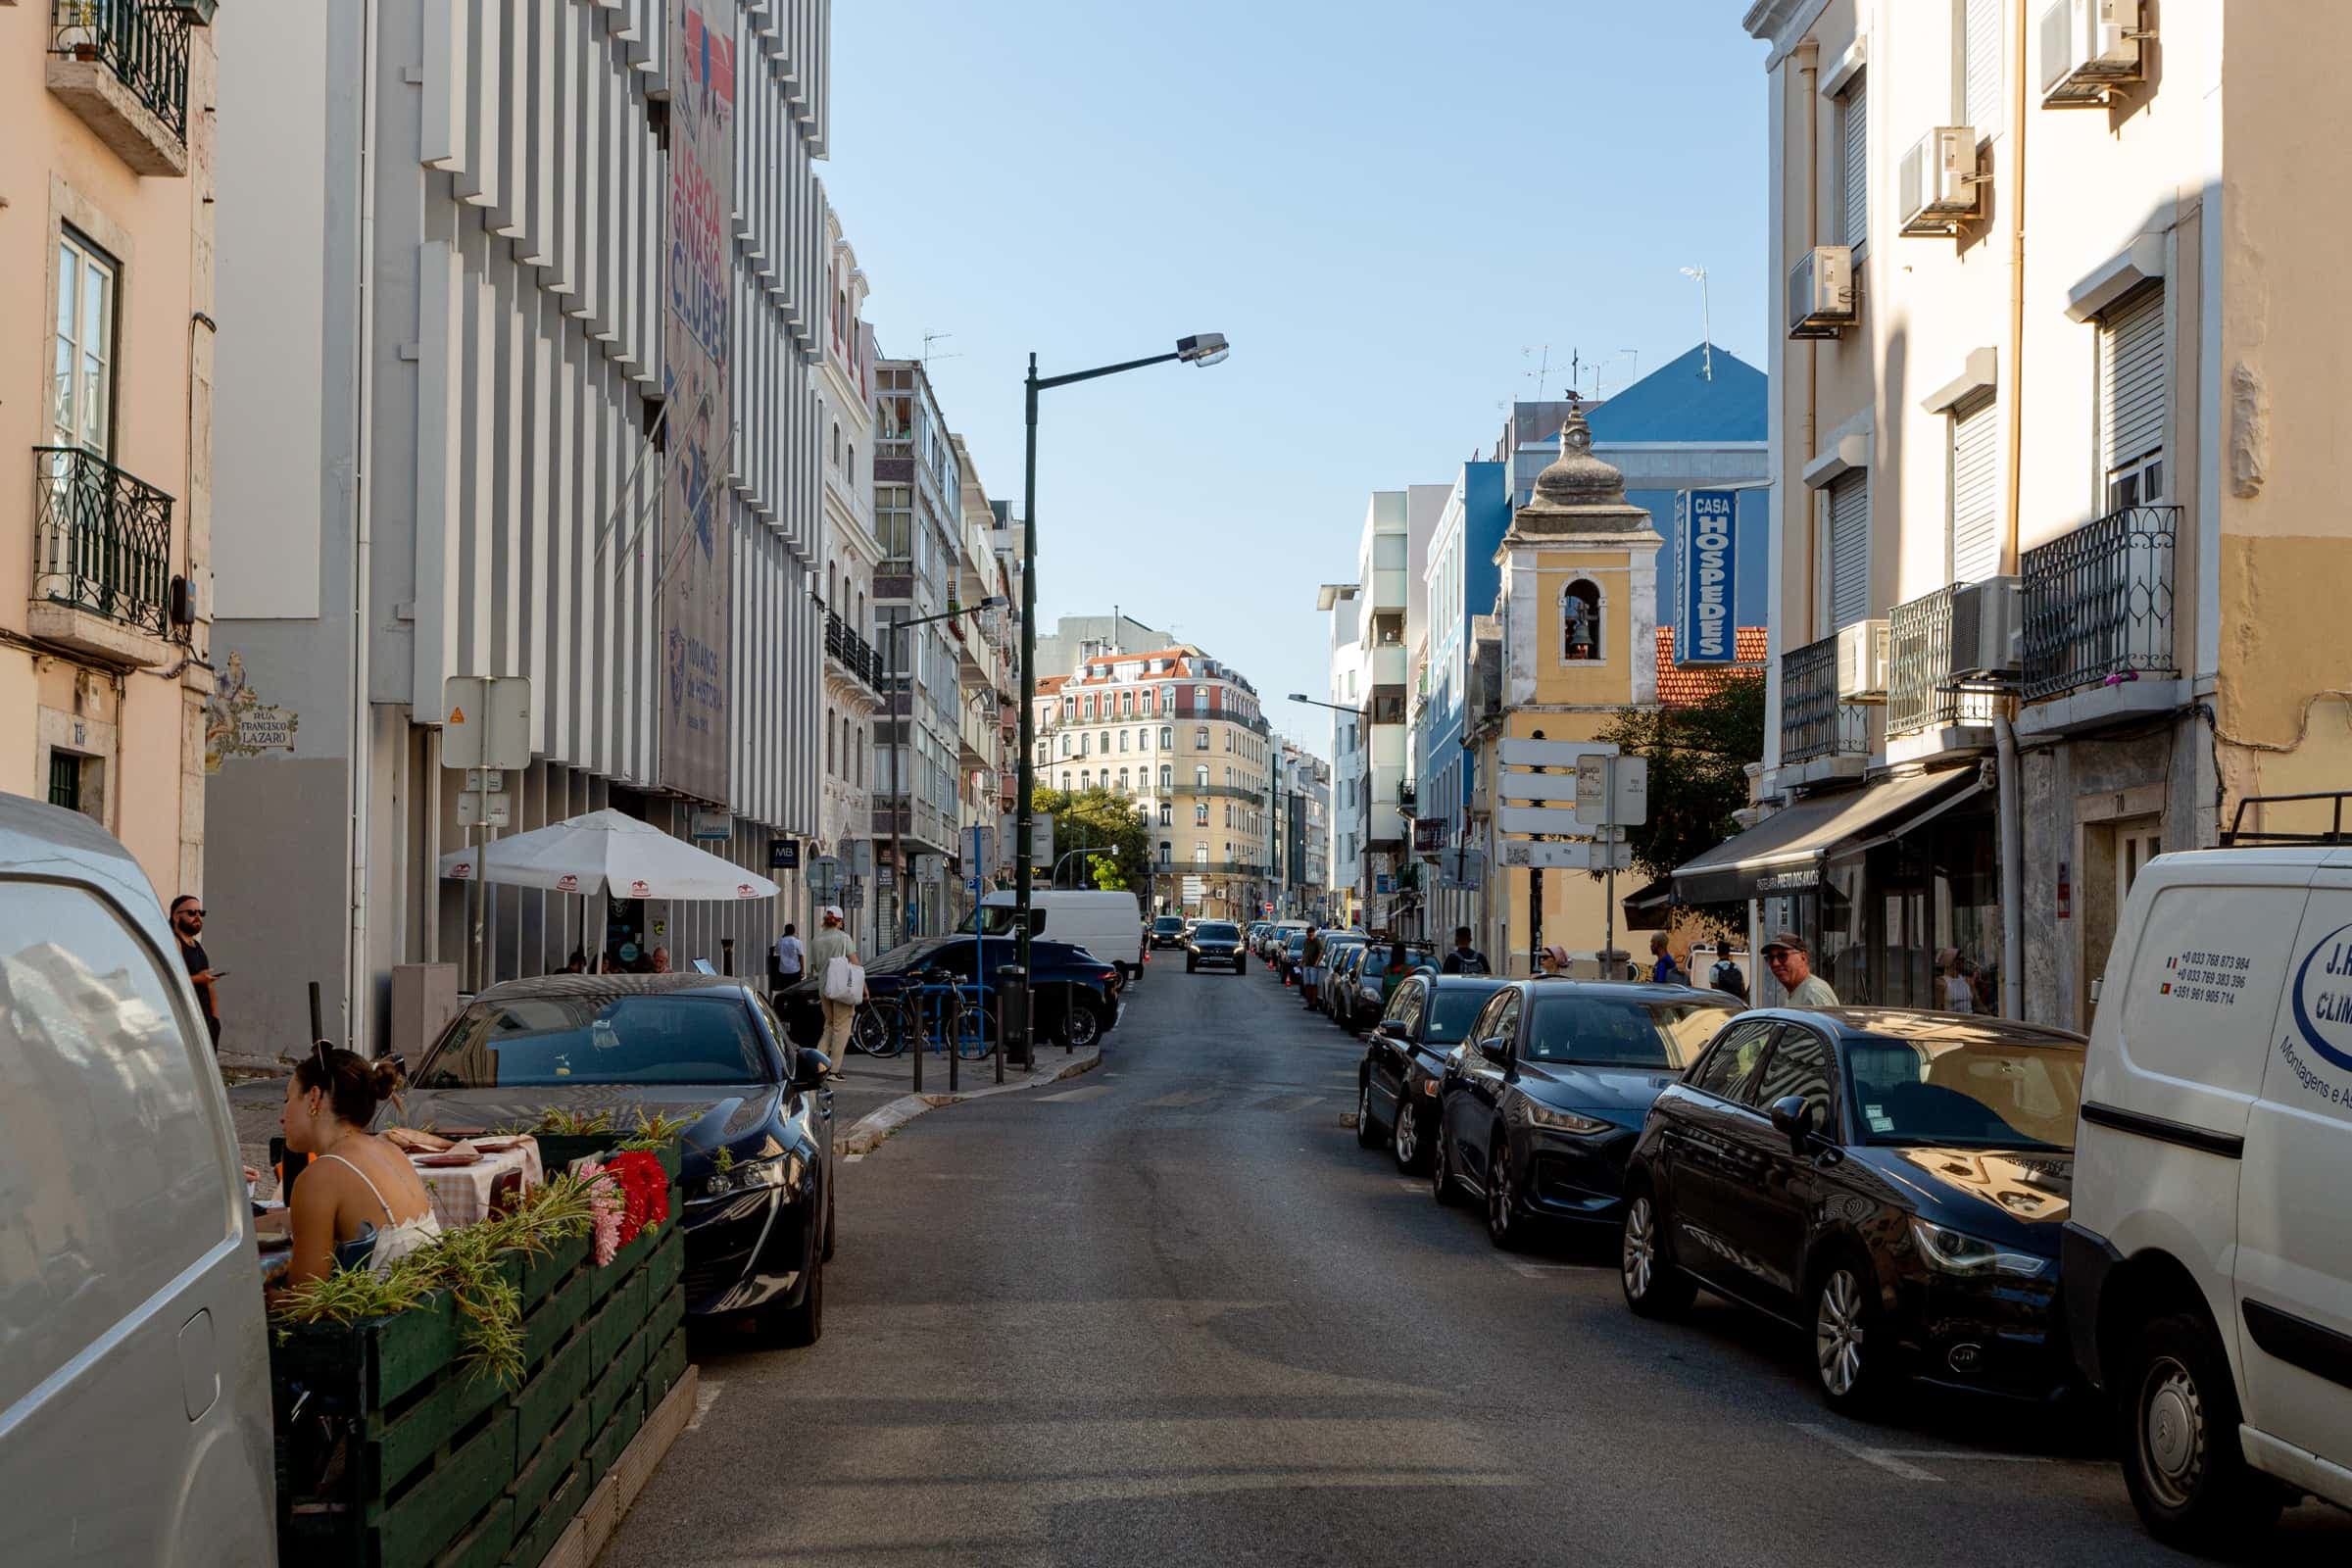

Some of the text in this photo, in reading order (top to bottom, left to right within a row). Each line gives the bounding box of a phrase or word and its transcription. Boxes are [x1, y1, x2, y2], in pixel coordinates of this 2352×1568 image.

[674, 125, 721, 250] LISBOA
[672, 242, 719, 357] CLUBE
[1695, 498, 1730, 514] CASA
[1695, 515, 1730, 656] HOSPEDES
[241, 721, 286, 731] FRANCISCO
[775, 847, 793, 858] MB
[1777, 872, 1792, 890] PRETO
[2191, 952, 2205, 965] 033
[2186, 968, 2201, 982] 033
[2173, 986, 2189, 999] +351
[2220, 992, 2235, 1006] 714
[2279, 1035, 2329, 1098] Montagens
[2331, 1088, 2340, 1102] e
